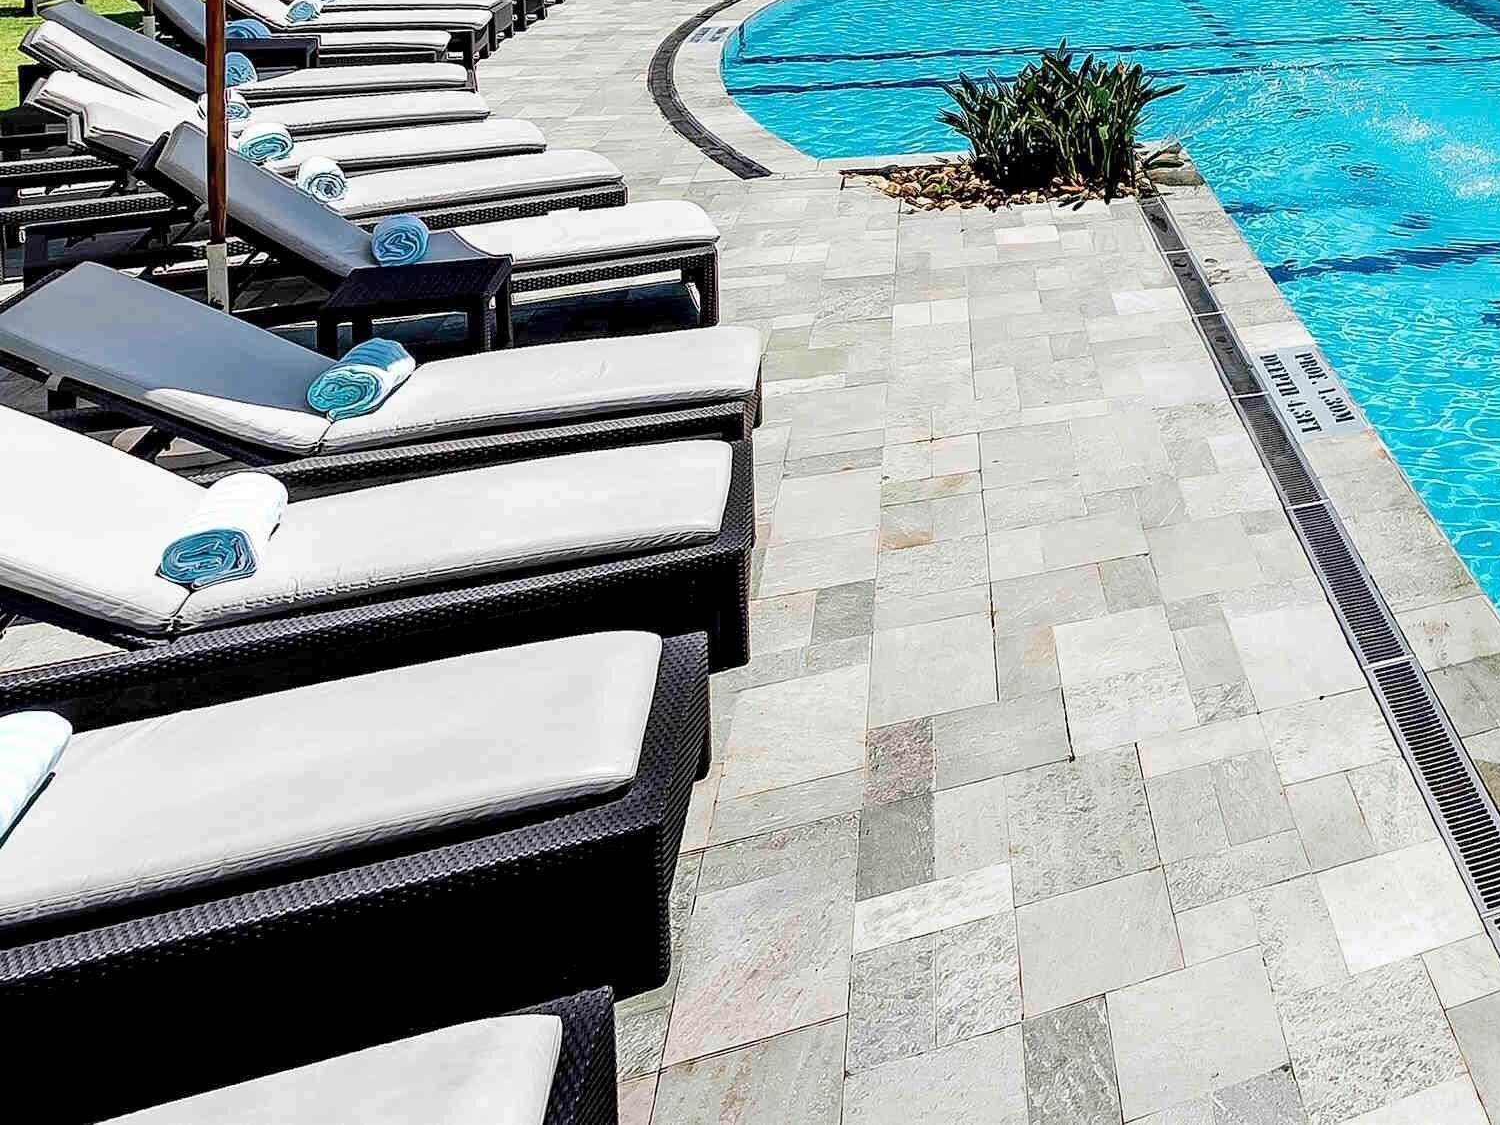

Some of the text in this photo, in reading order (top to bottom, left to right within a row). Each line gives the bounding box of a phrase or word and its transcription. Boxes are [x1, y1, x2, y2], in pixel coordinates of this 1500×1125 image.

[1260, 354, 1299, 397] DEEPTH
[1295, 352, 1355, 423] PROF. 1,30M
